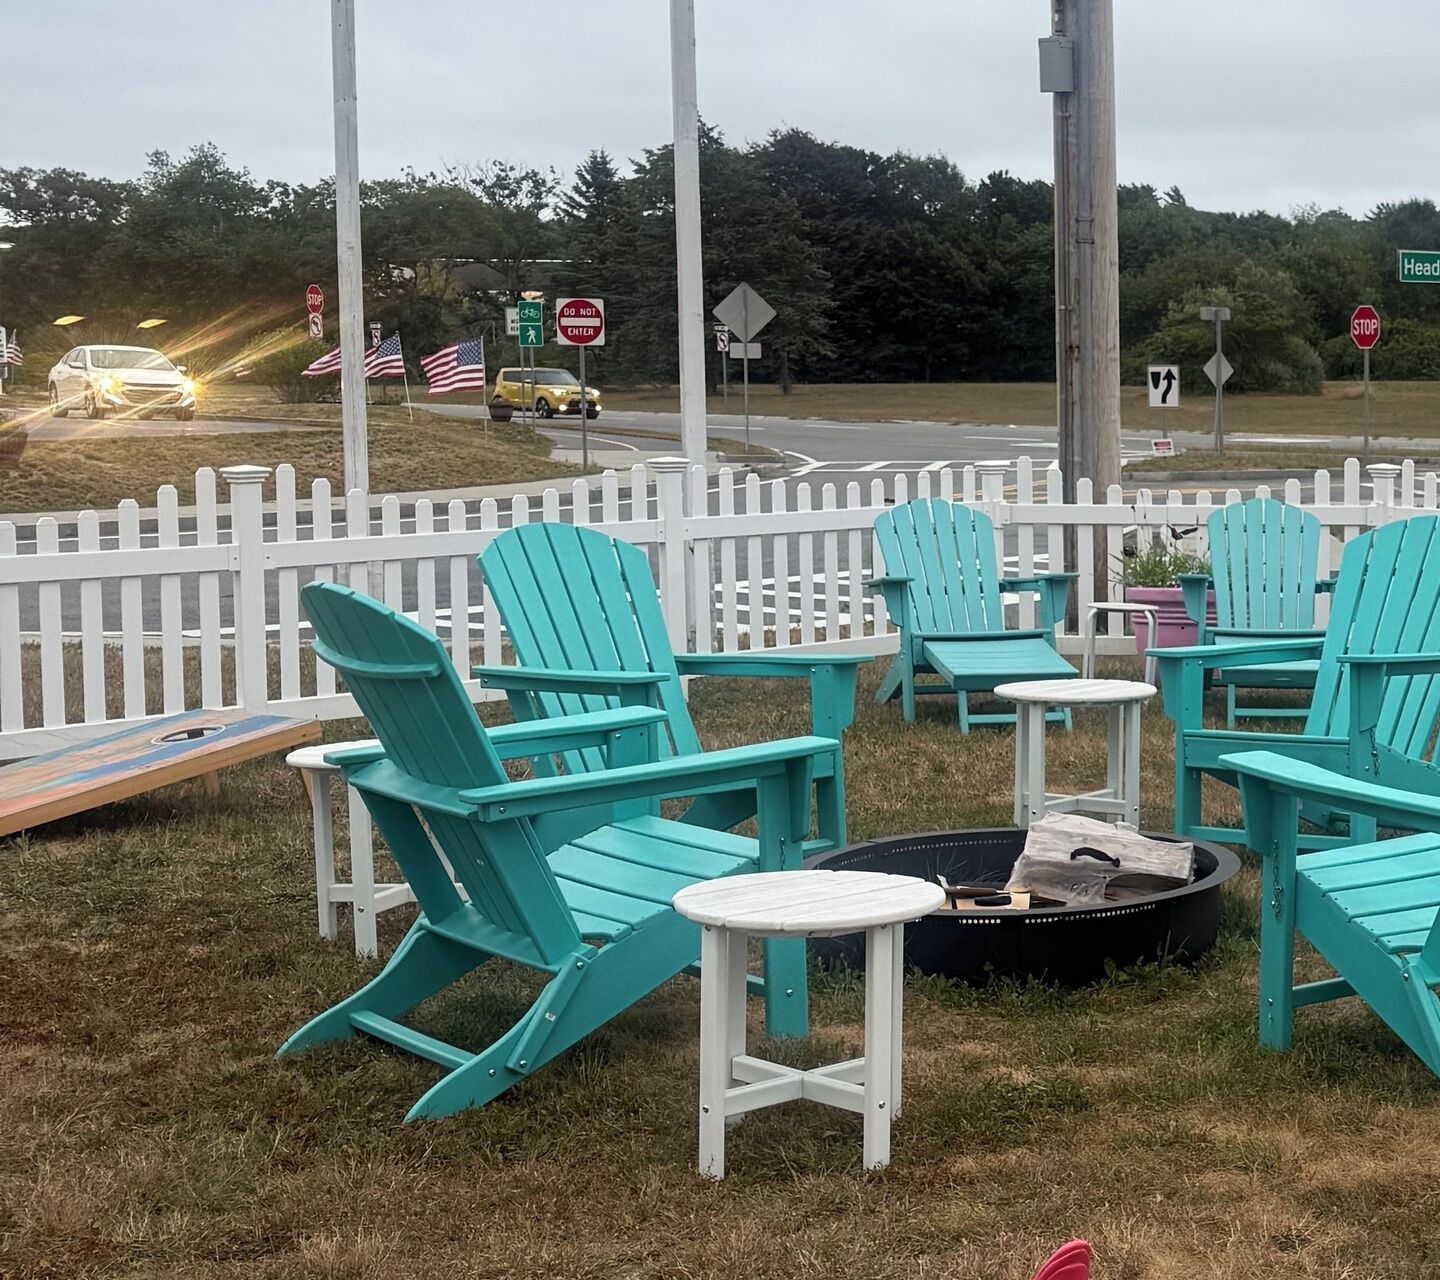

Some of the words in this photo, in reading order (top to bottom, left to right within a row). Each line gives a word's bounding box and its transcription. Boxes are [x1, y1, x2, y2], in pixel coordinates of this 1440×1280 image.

[1404, 258, 1440, 276] Head
[307, 293, 322, 305] STOP
[563, 308, 576, 316] DO
[580, 308, 596, 316] NOT
[567, 327, 594, 336] ENTER
[1353, 319, 1378, 336] STOP
